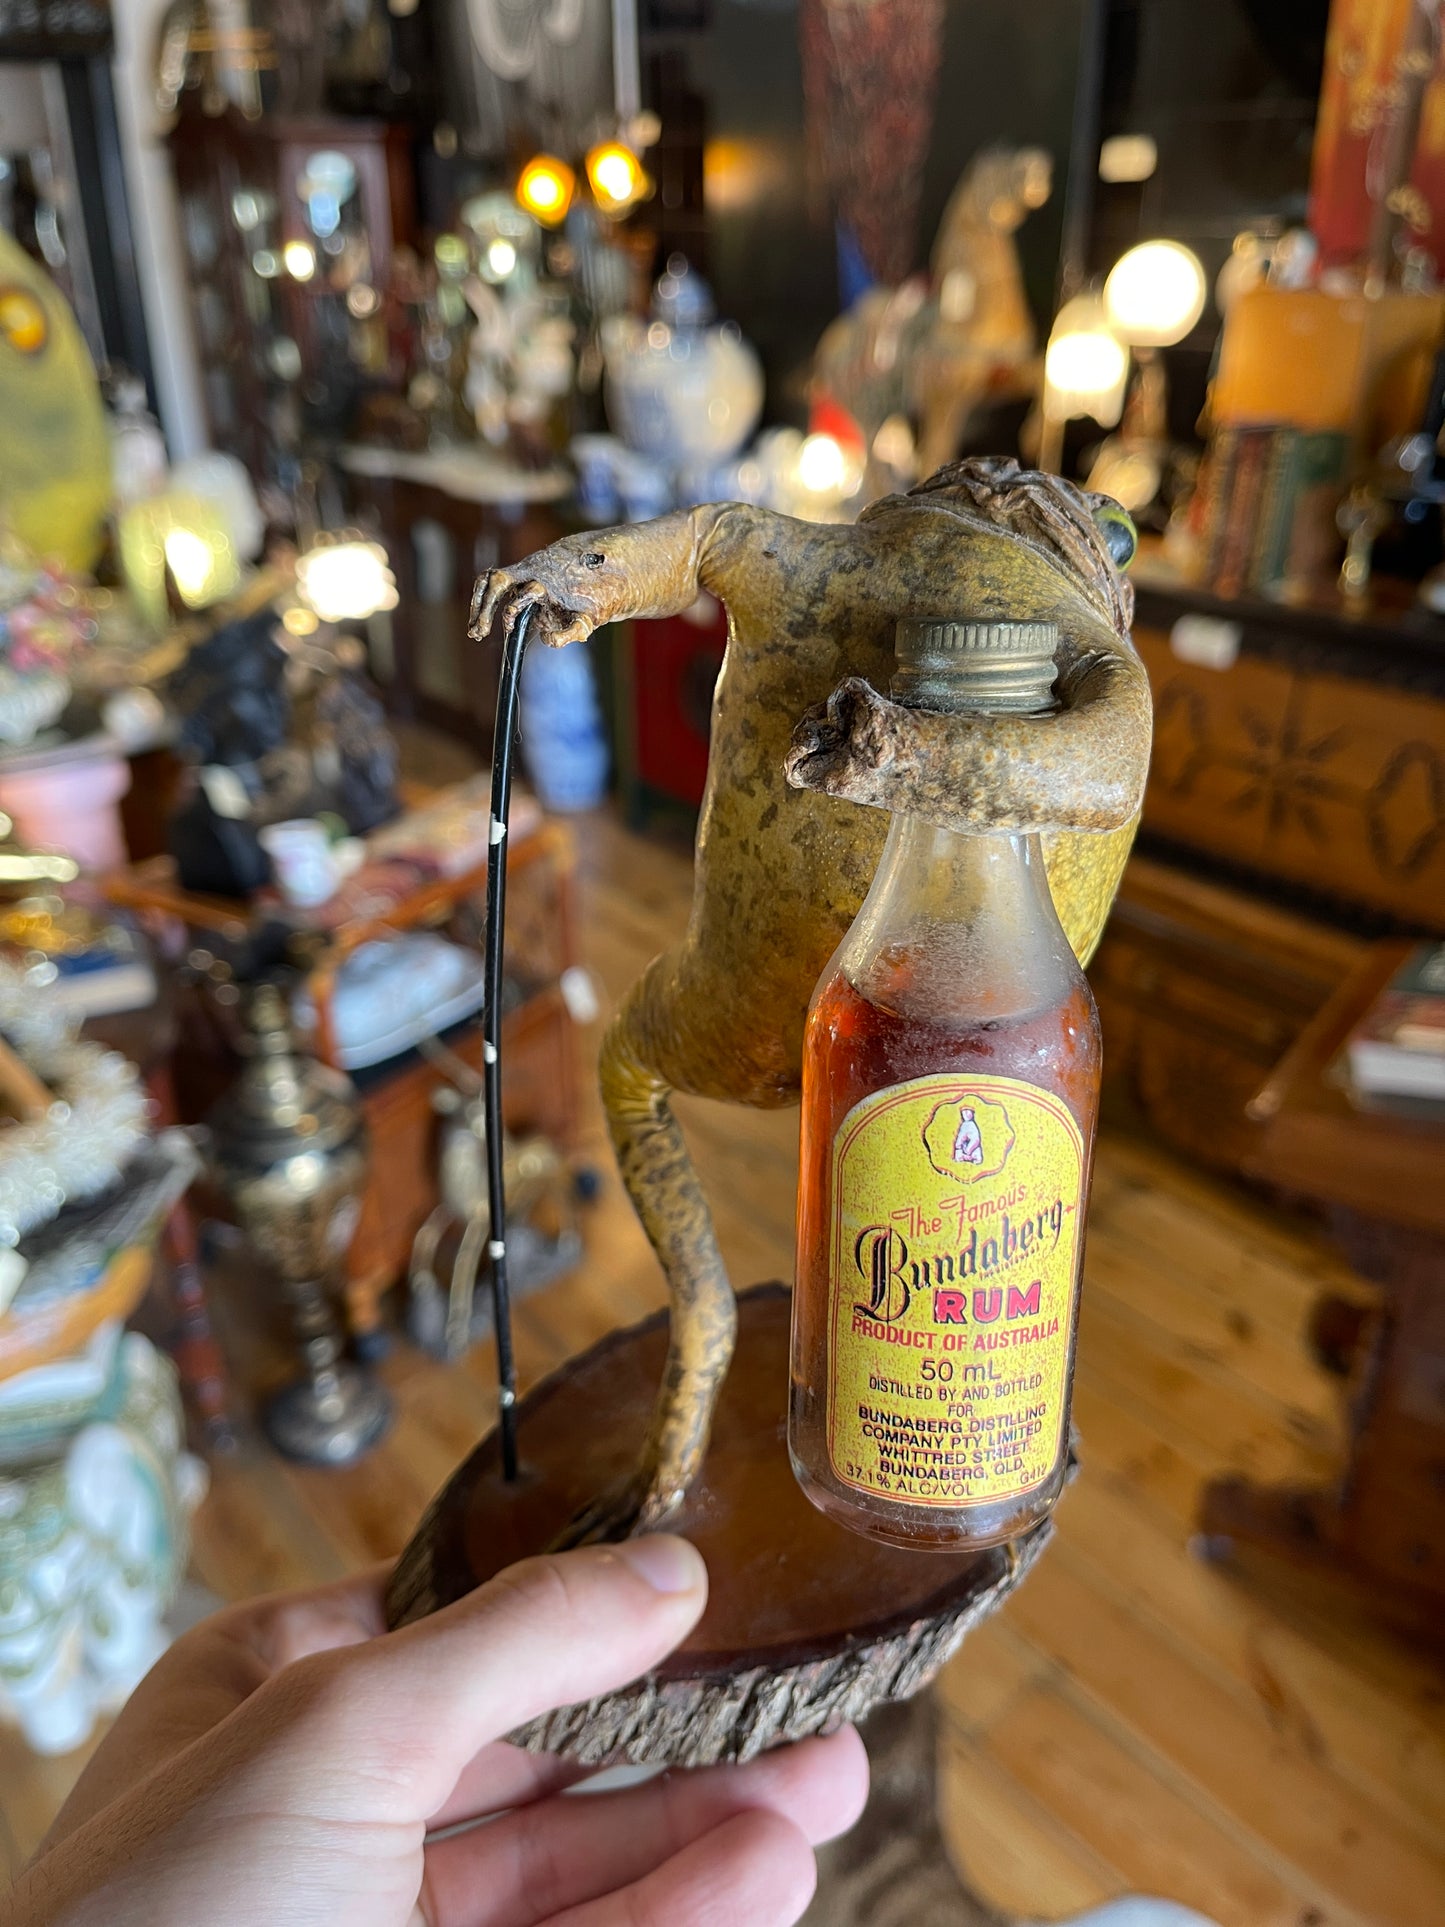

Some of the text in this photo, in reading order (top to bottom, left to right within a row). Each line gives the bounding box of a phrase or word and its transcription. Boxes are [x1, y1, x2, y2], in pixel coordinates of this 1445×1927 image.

[891, 1184, 1026, 1245] The Famous
[854, 1198, 1064, 1325] Bundaberg
[933, 1281, 1042, 1325] RUM
[853, 1318, 1060, 1351] PRODUCT OF AUSTRALIA
[921, 1359, 1001, 1381] 50 mL
[869, 1374, 1043, 1401] DISTILLED BY AND BOTTLED
[859, 1403, 1047, 1433] BUNDABERG DISTILLING
[948, 1403, 974, 1417] FOR
[863, 1421, 1042, 1449] COMPANY PTY LIMITED
[879, 1442, 1029, 1465] WHITTRED STREET
[880, 1460, 989, 1481] BUNDABERG,
[896, 1479, 974, 1496] ALC/VOL
